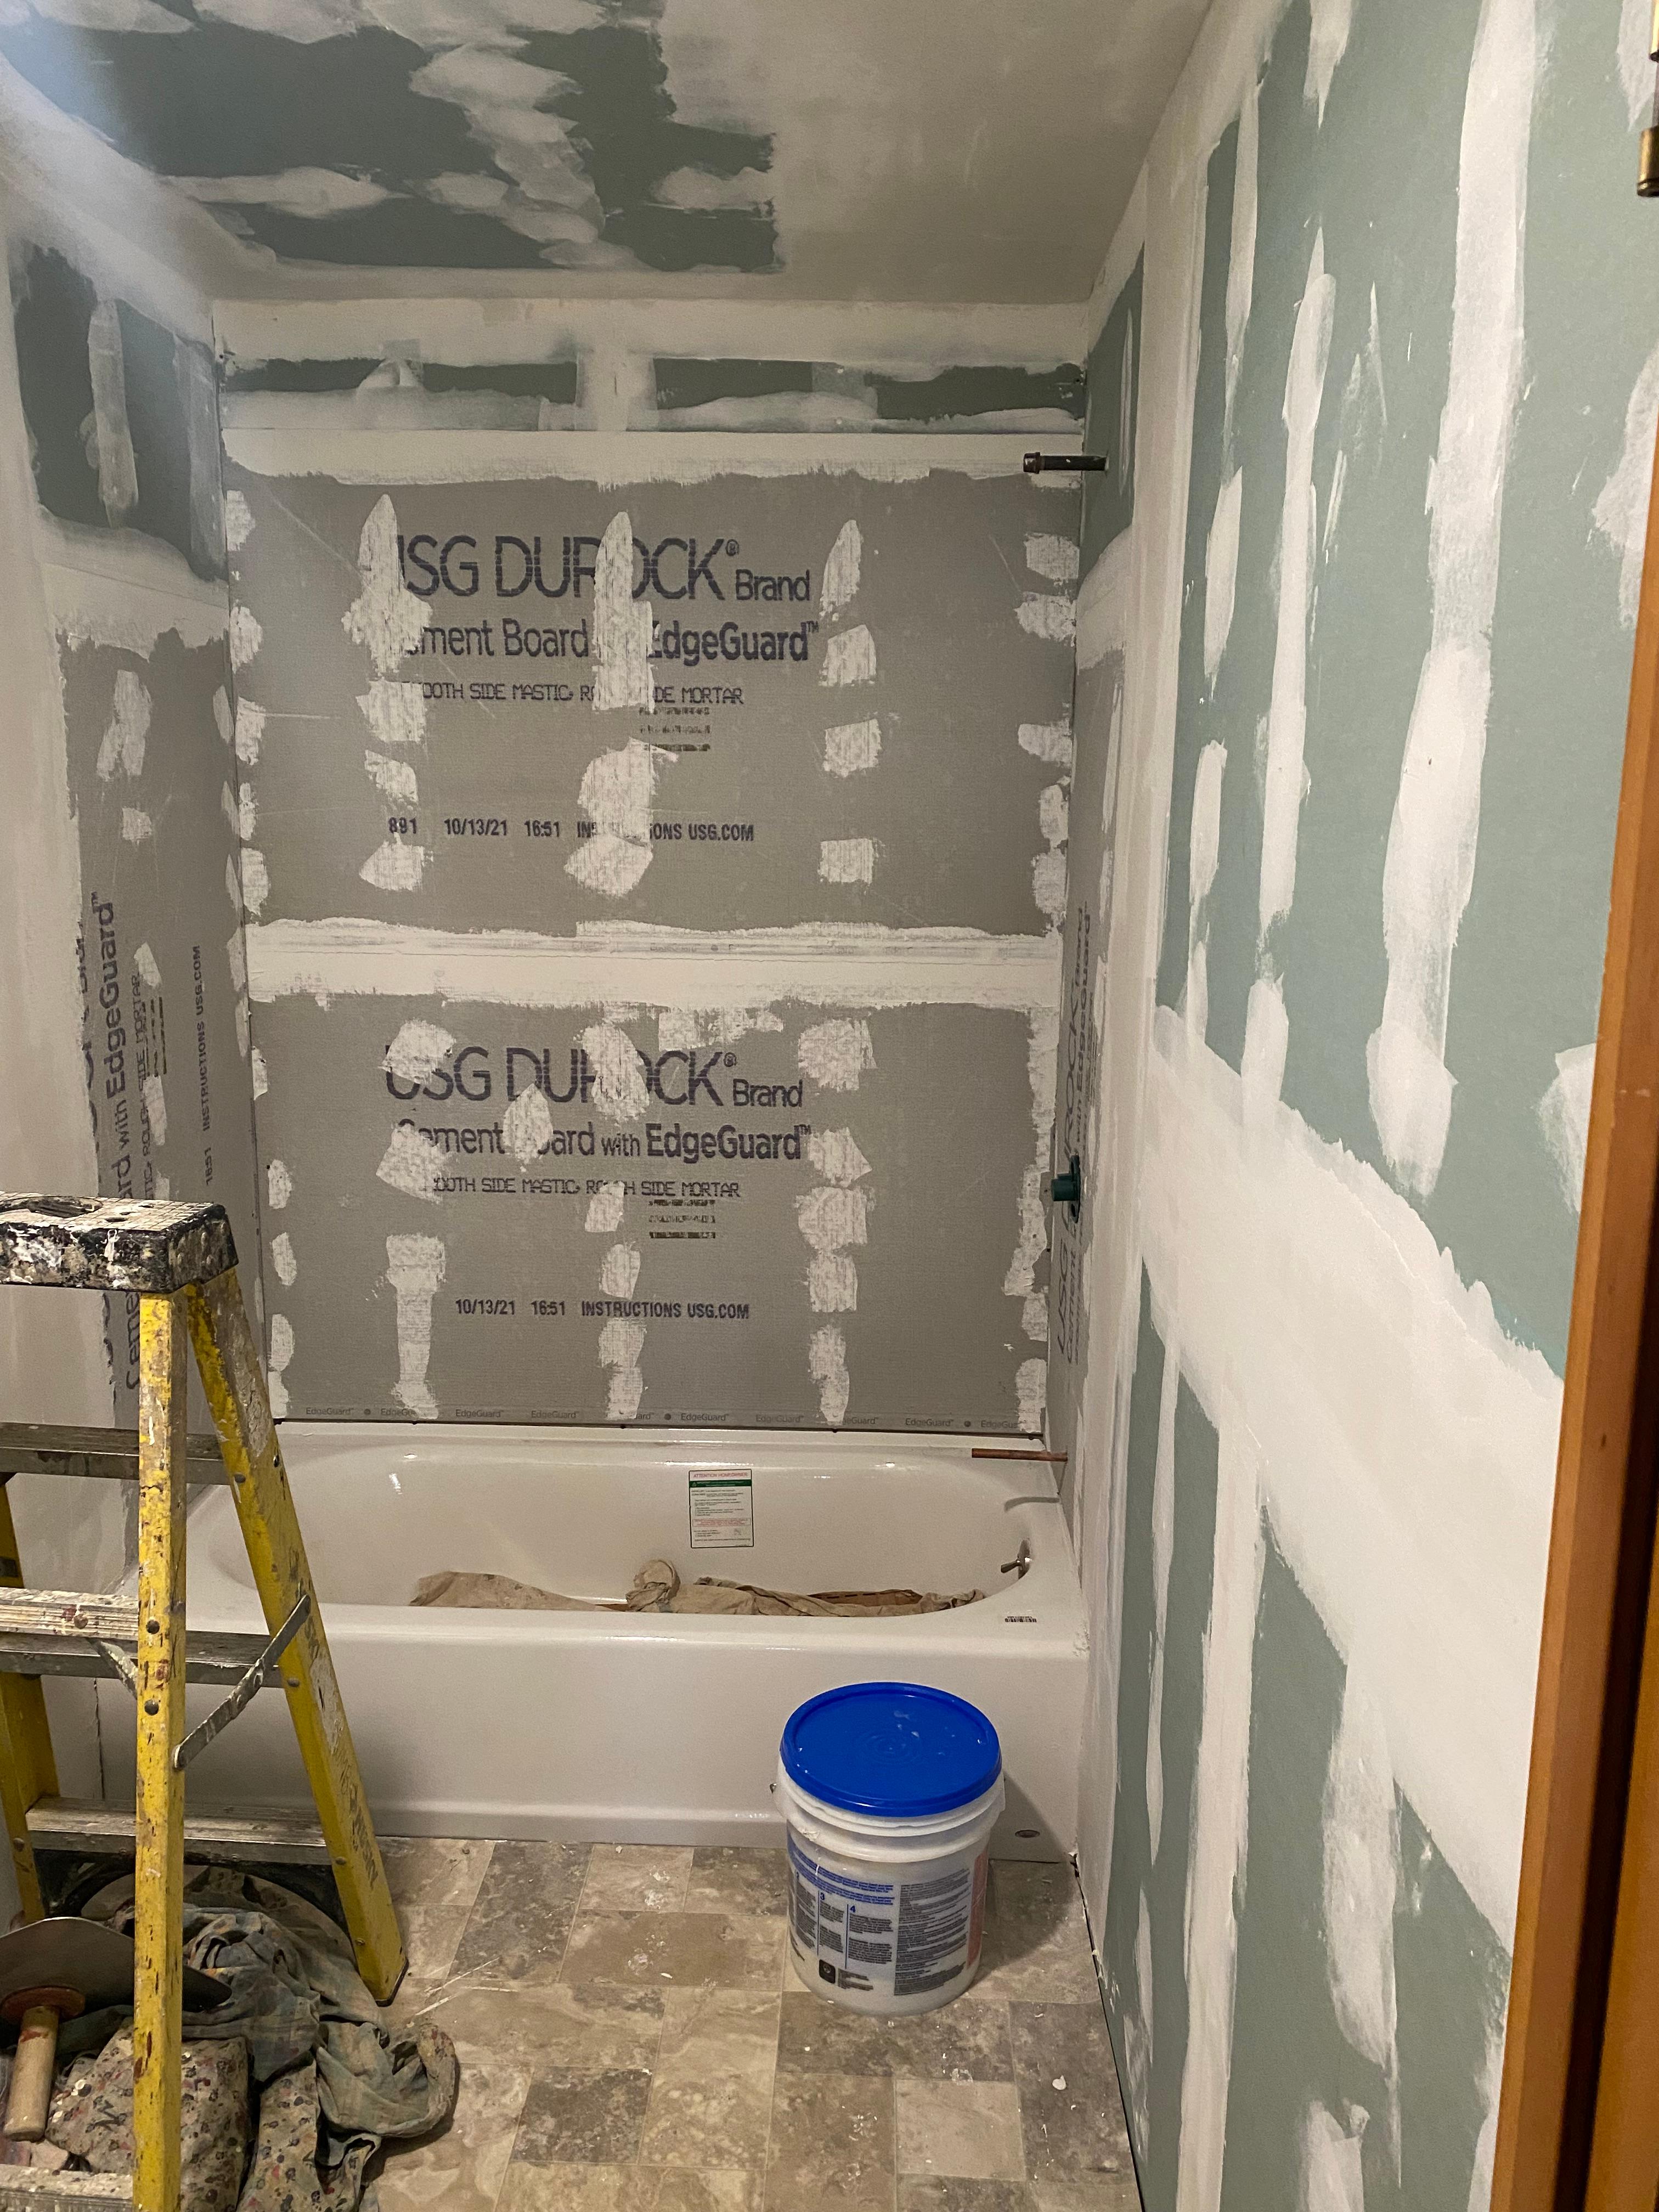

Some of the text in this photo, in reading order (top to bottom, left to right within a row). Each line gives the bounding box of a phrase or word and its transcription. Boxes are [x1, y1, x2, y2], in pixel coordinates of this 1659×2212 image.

[736, 569, 810, 601] Brand
[407, 619, 494, 656] ment
[502, 618, 589, 658] Board
[470, 683, 506, 700] SIDE
[653, 686, 675, 703] DE
[682, 687, 744, 704] MORTAR
[444, 817, 507, 836] 10/13/21
[524, 820, 560, 837] 16:51
[688, 823, 754, 841] USG.COM
[197, 1021, 211, 1132] INSTRUCTIONS
[733, 1079, 803, 1107] Brand
[114, 1099, 131, 1150] with
[398, 1119, 505, 1154] ment
[538, 1121, 595, 1156] ard
[601, 1133, 640, 1156] with
[111, 1154, 133, 1199] ard
[482, 1177, 516, 1193] SIDE
[641, 1181, 675, 1197] SIDE
[682, 1182, 741, 1198] MORTAR
[456, 1299, 749, 1319] 10/13/21 16:51 INSTRUCTIONS USG.COM
[126, 1292, 140, 1390] Ceme
